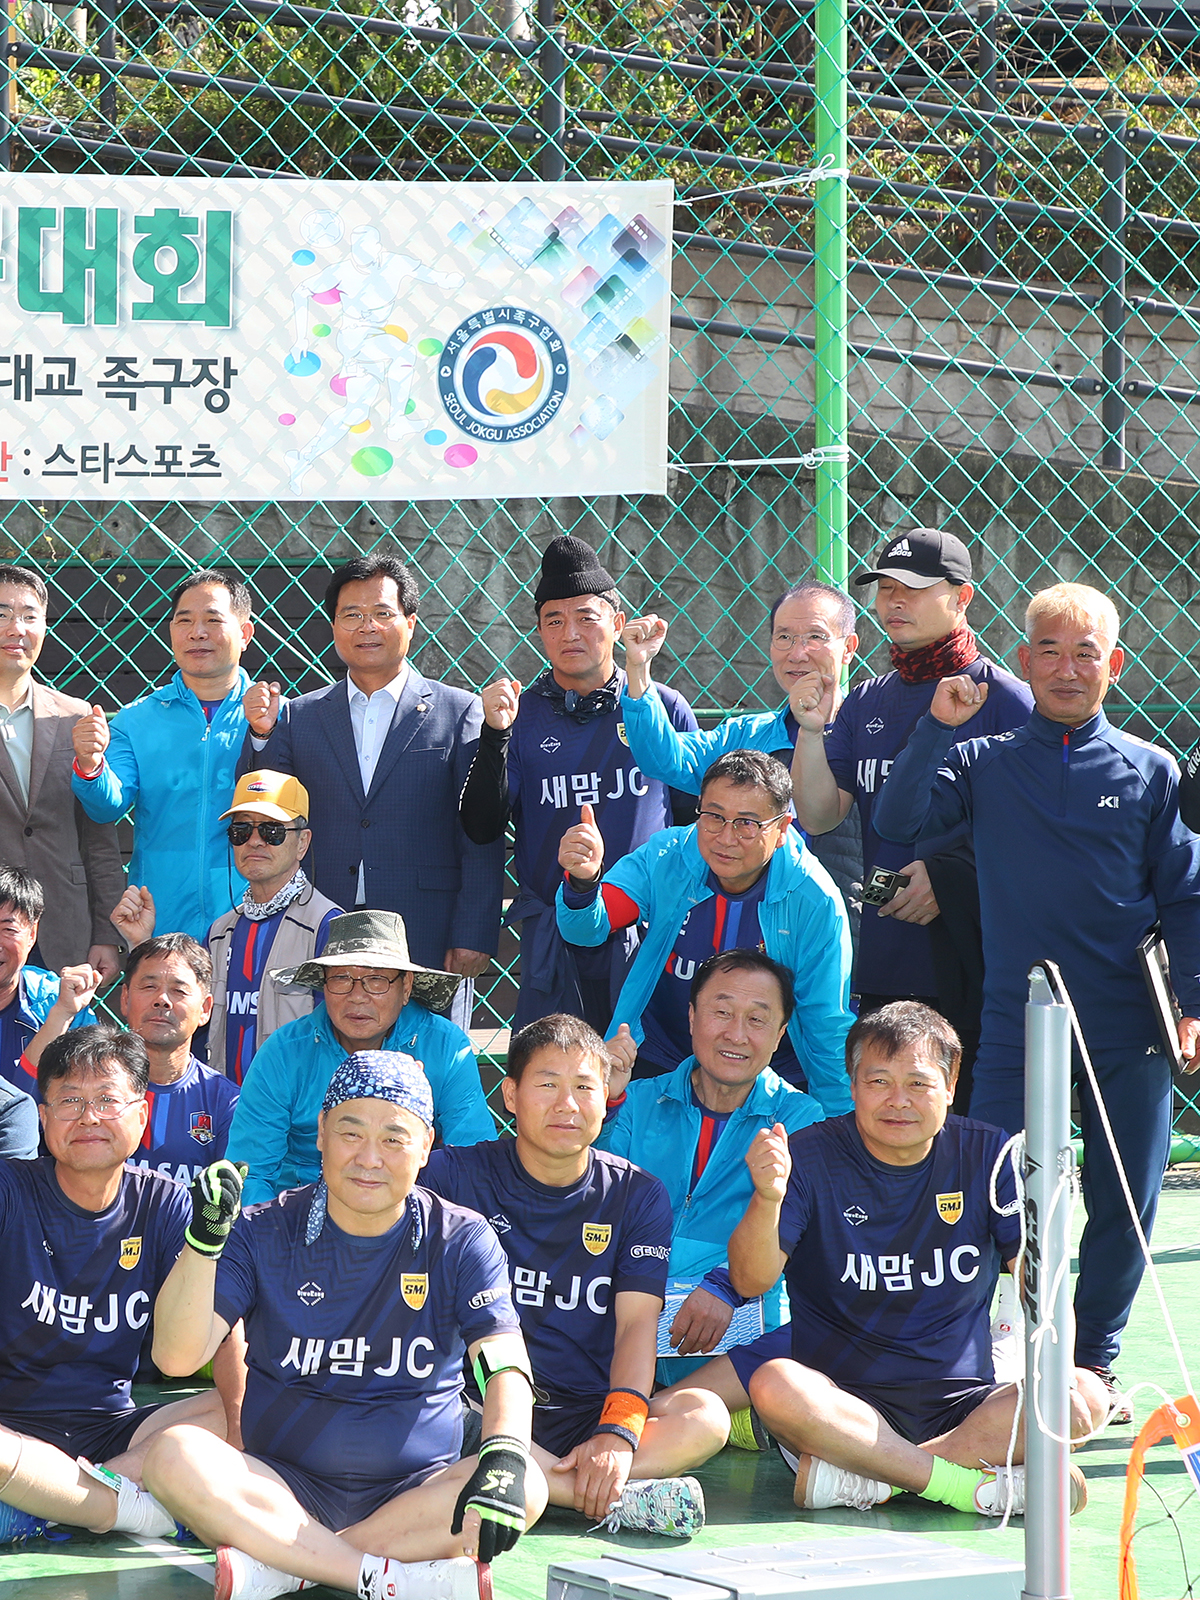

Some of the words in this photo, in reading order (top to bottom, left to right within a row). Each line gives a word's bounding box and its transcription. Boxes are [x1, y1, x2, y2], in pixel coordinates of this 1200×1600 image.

[447, 308, 562, 354] 서울특별시족구협회
[96, 356, 238, 414] 족구장
[443, 391, 468, 426] SEOUL
[465, 421, 503, 440] JOKGU
[506, 390, 564, 440] ASSOCIATION
[40, 442, 223, 484] 스타스포츠
[939, 1201, 961, 1213] SMJ
[584, 1232, 609, 1244] SMJ
[513, 1265, 613, 1316] 맘JC
[840, 1244, 980, 1292] 새맘JC
[20, 1280, 150, 1334] 새맘JC
[280, 1336, 436, 1379] 새맘JC
